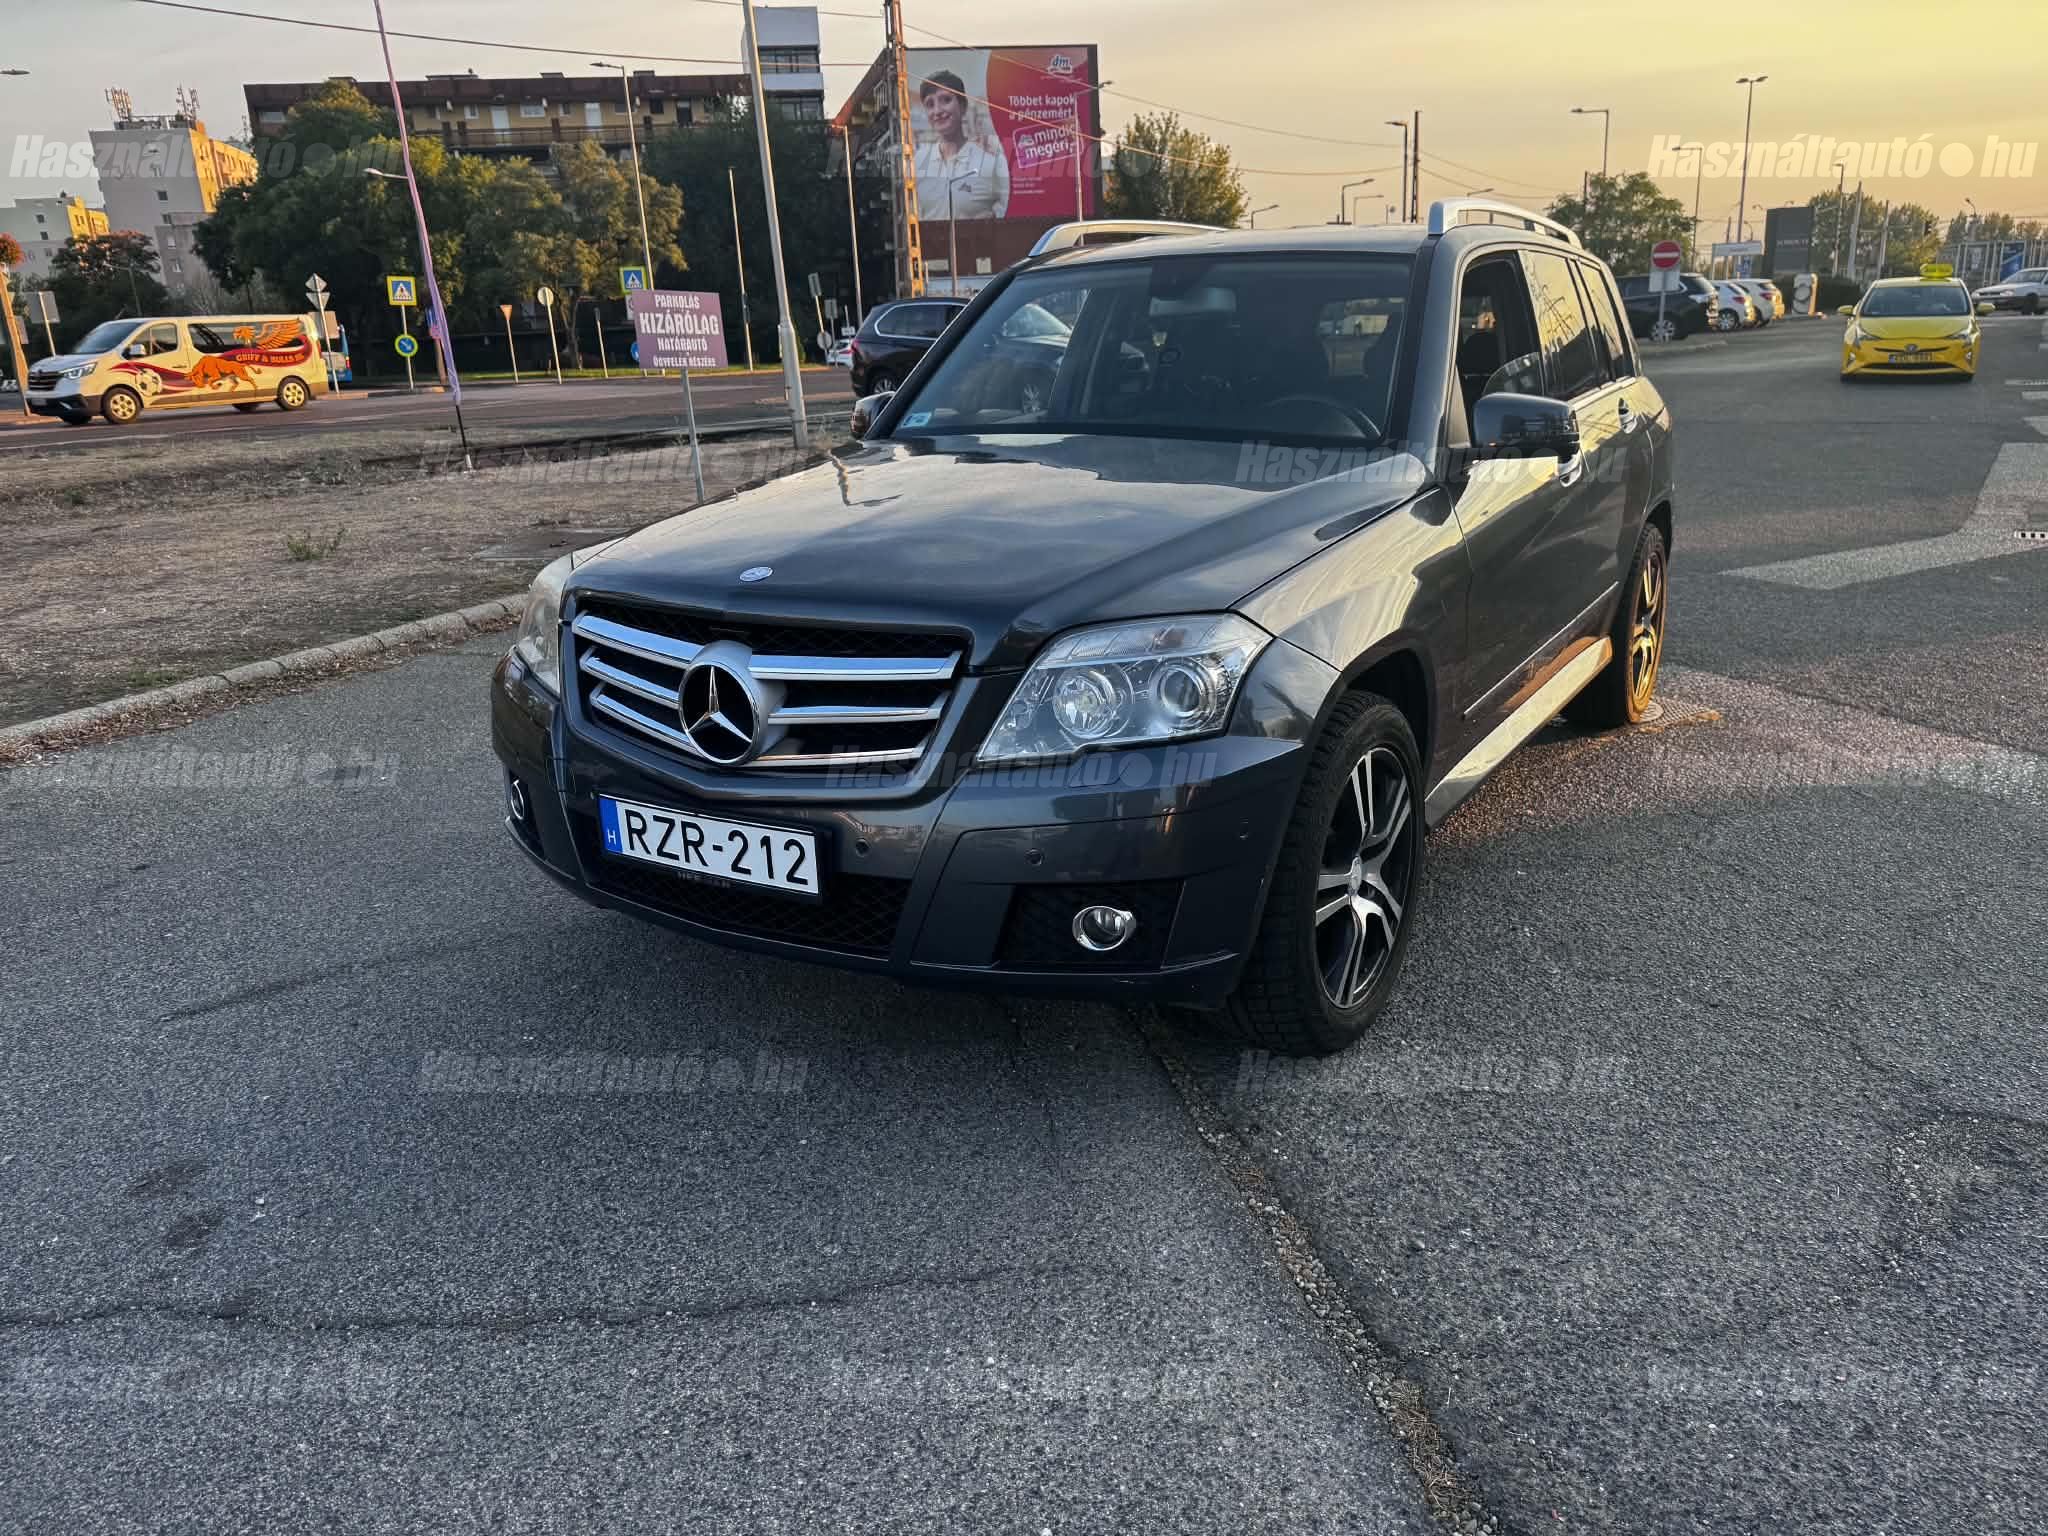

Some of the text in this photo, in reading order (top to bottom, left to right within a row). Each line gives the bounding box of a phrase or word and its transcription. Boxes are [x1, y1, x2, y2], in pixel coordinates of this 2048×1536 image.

[654, 294, 701, 309] PARKOLÁS
[639, 310, 720, 335] KIZÁRÓLAG
[607, 809, 809, 886] H RZR-212
